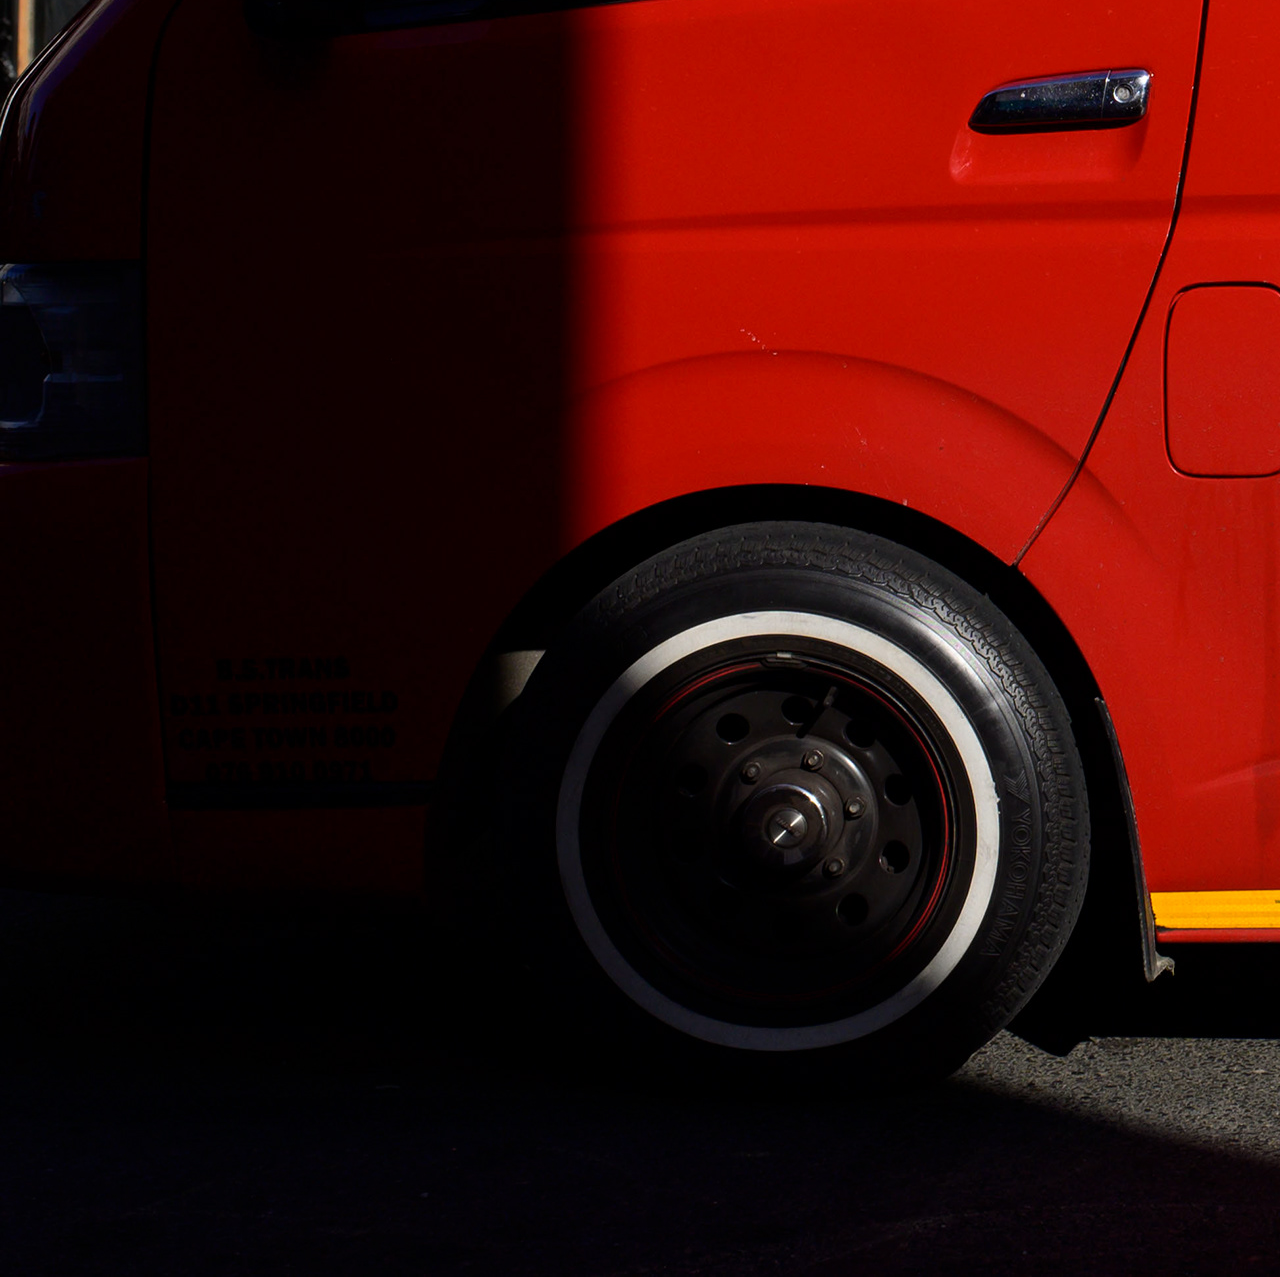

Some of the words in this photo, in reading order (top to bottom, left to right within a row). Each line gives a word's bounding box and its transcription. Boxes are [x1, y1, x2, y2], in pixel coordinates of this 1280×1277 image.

[227, 689, 399, 715] SPRINGFIELD
[178, 726, 246, 750] CAPE
[252, 725, 327, 750] TOWN
[979, 808, 1032, 957] YOKOHAMA
